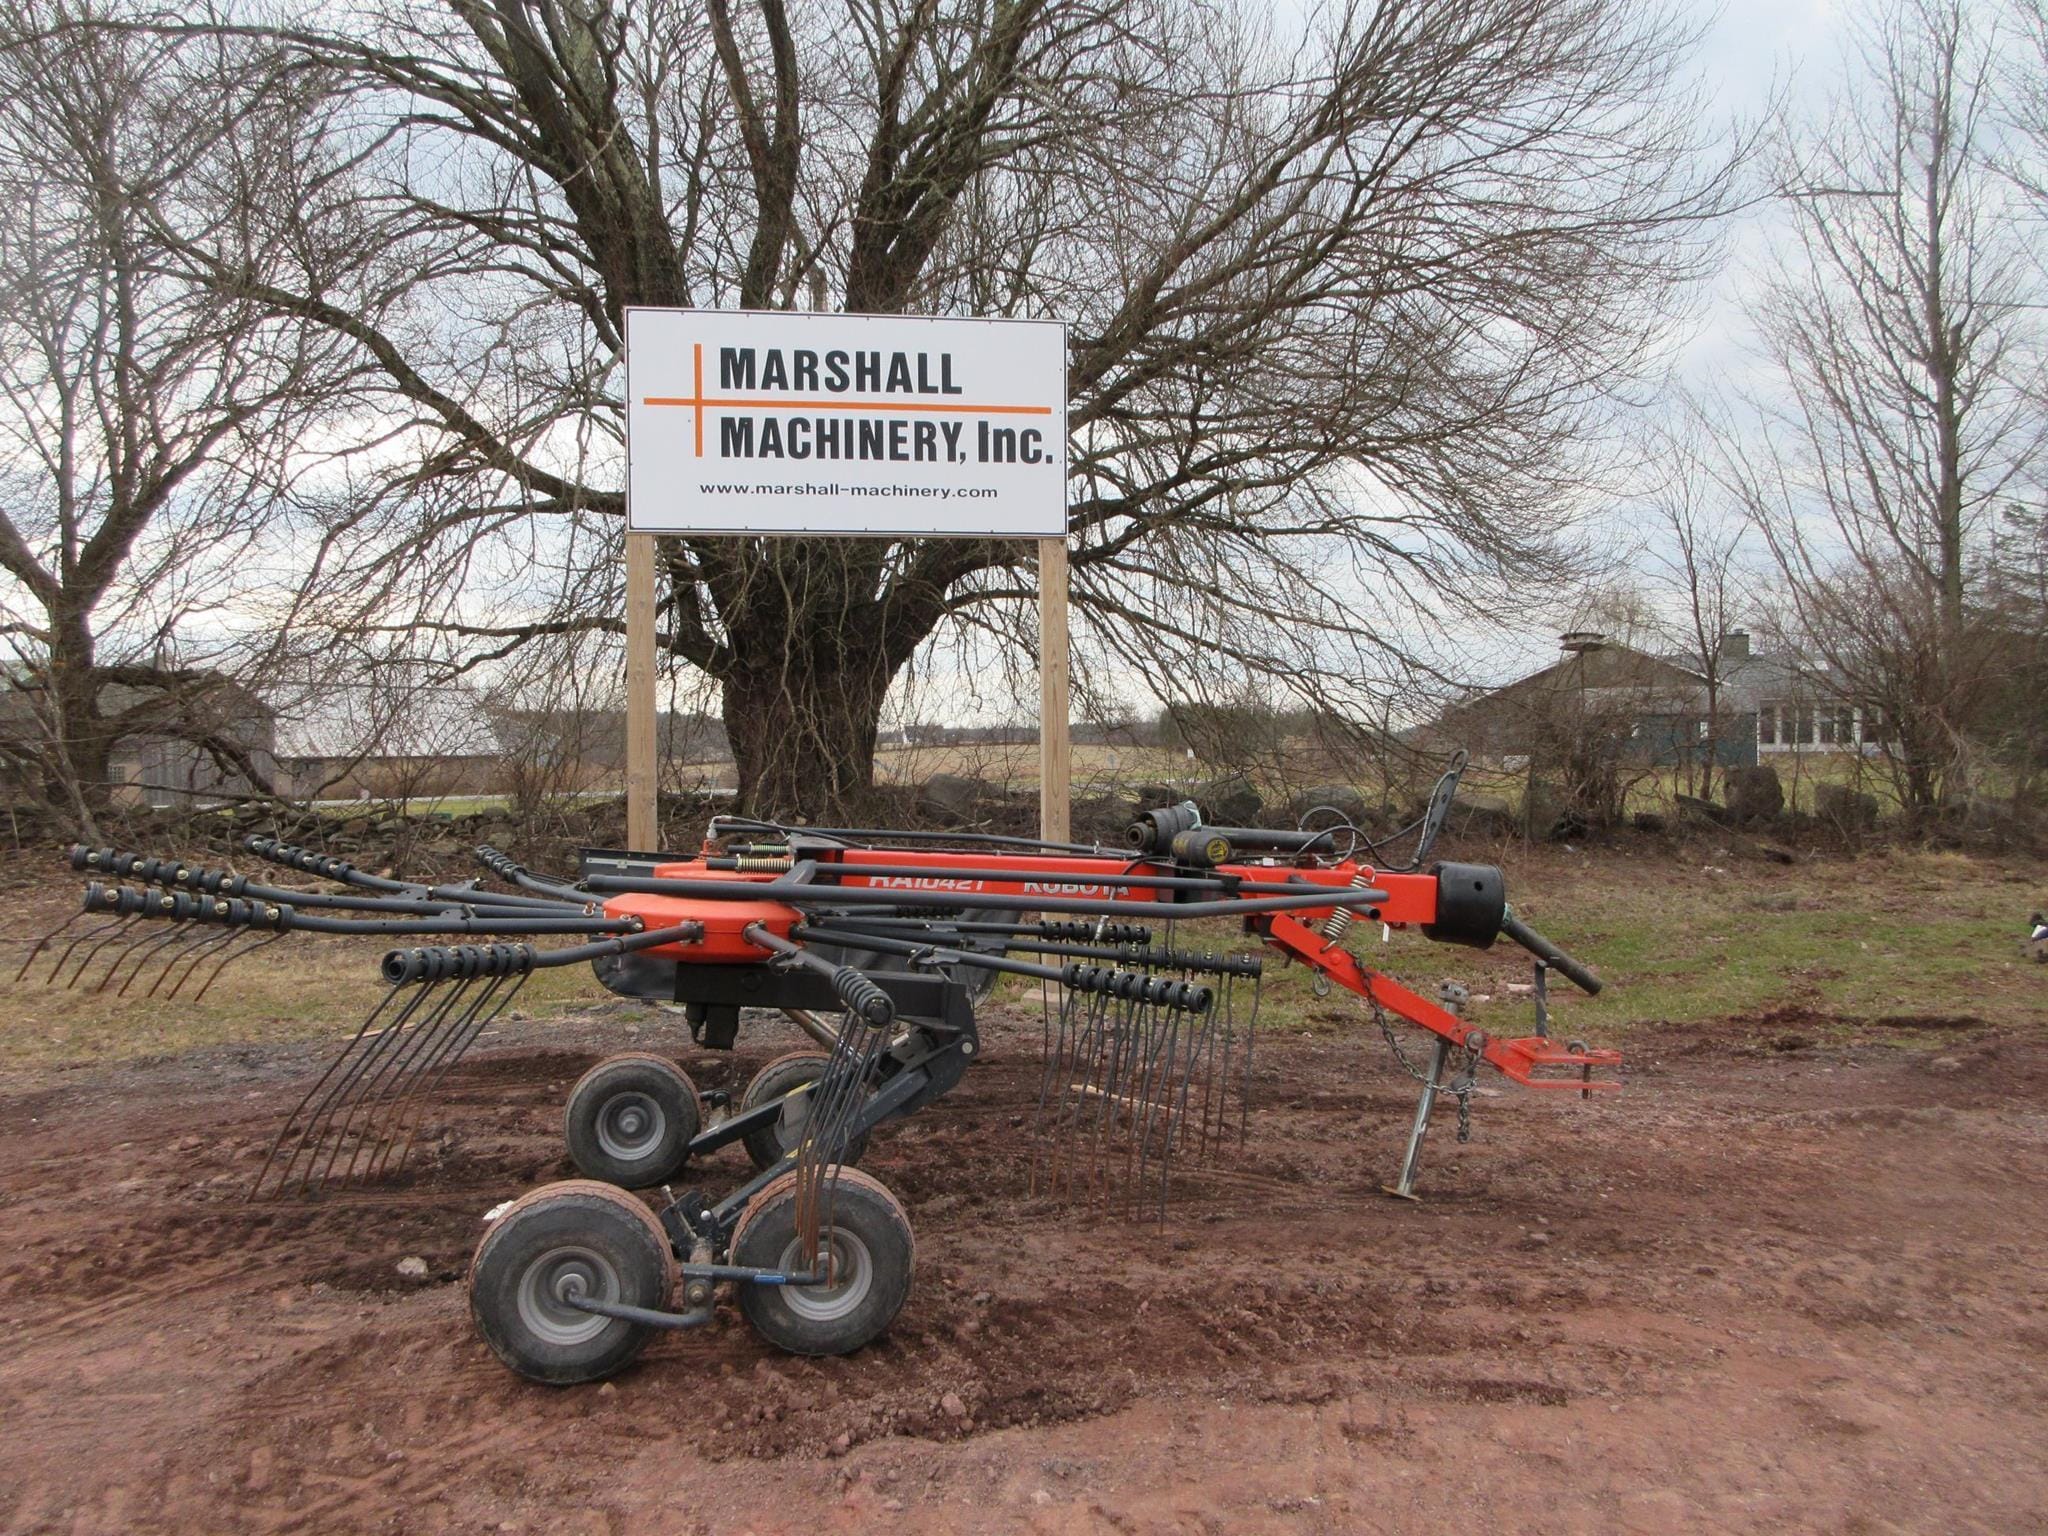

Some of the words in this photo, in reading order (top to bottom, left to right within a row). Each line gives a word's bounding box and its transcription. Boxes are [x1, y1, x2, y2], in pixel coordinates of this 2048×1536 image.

[720, 347, 963, 395] MARSHALL
[720, 417, 967, 465] MACHINERY,
[977, 420, 1054, 465] Inc.
[699, 483, 998, 499] www.marshall-machinery.com
